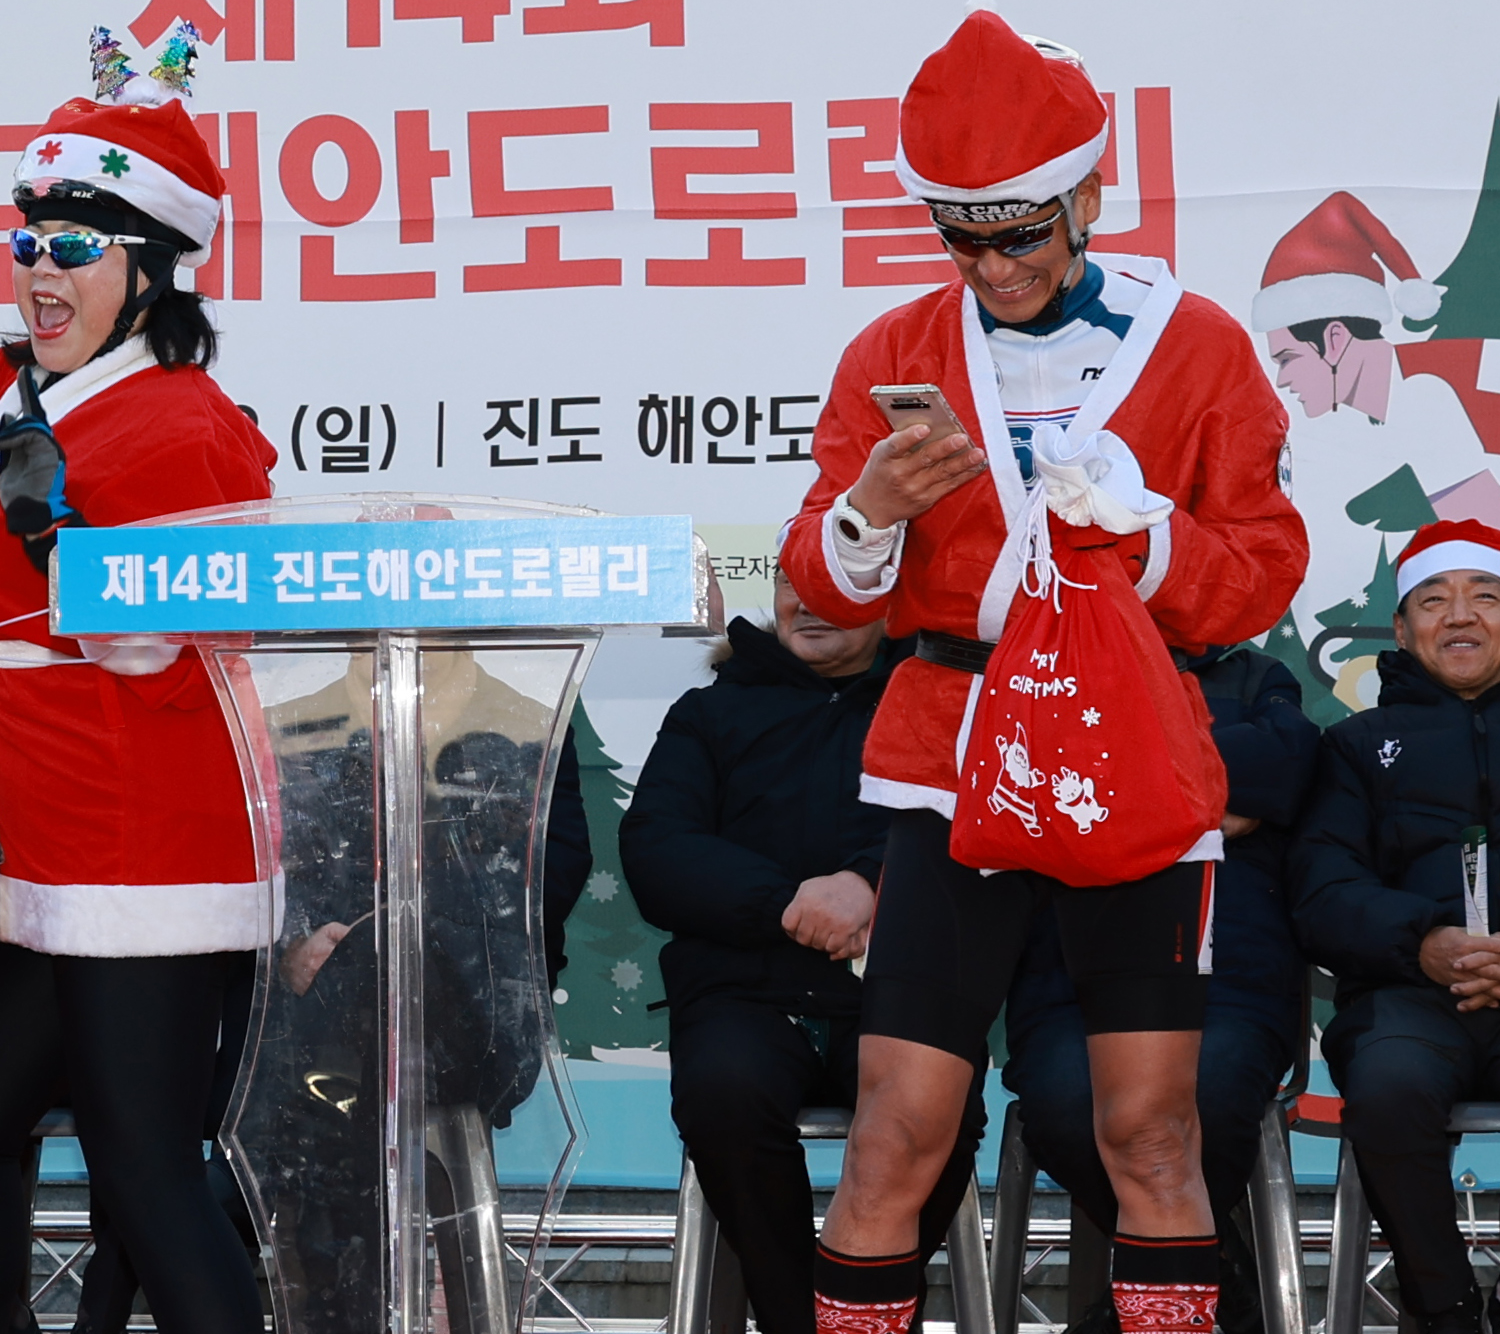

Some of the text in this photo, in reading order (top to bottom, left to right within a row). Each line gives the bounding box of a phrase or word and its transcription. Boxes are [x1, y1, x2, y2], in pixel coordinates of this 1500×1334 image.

[291, 404, 398, 473] (일)
[482, 395, 602, 467] 진도
[102, 544, 650, 605] 제14회 진도해안도로랠리
